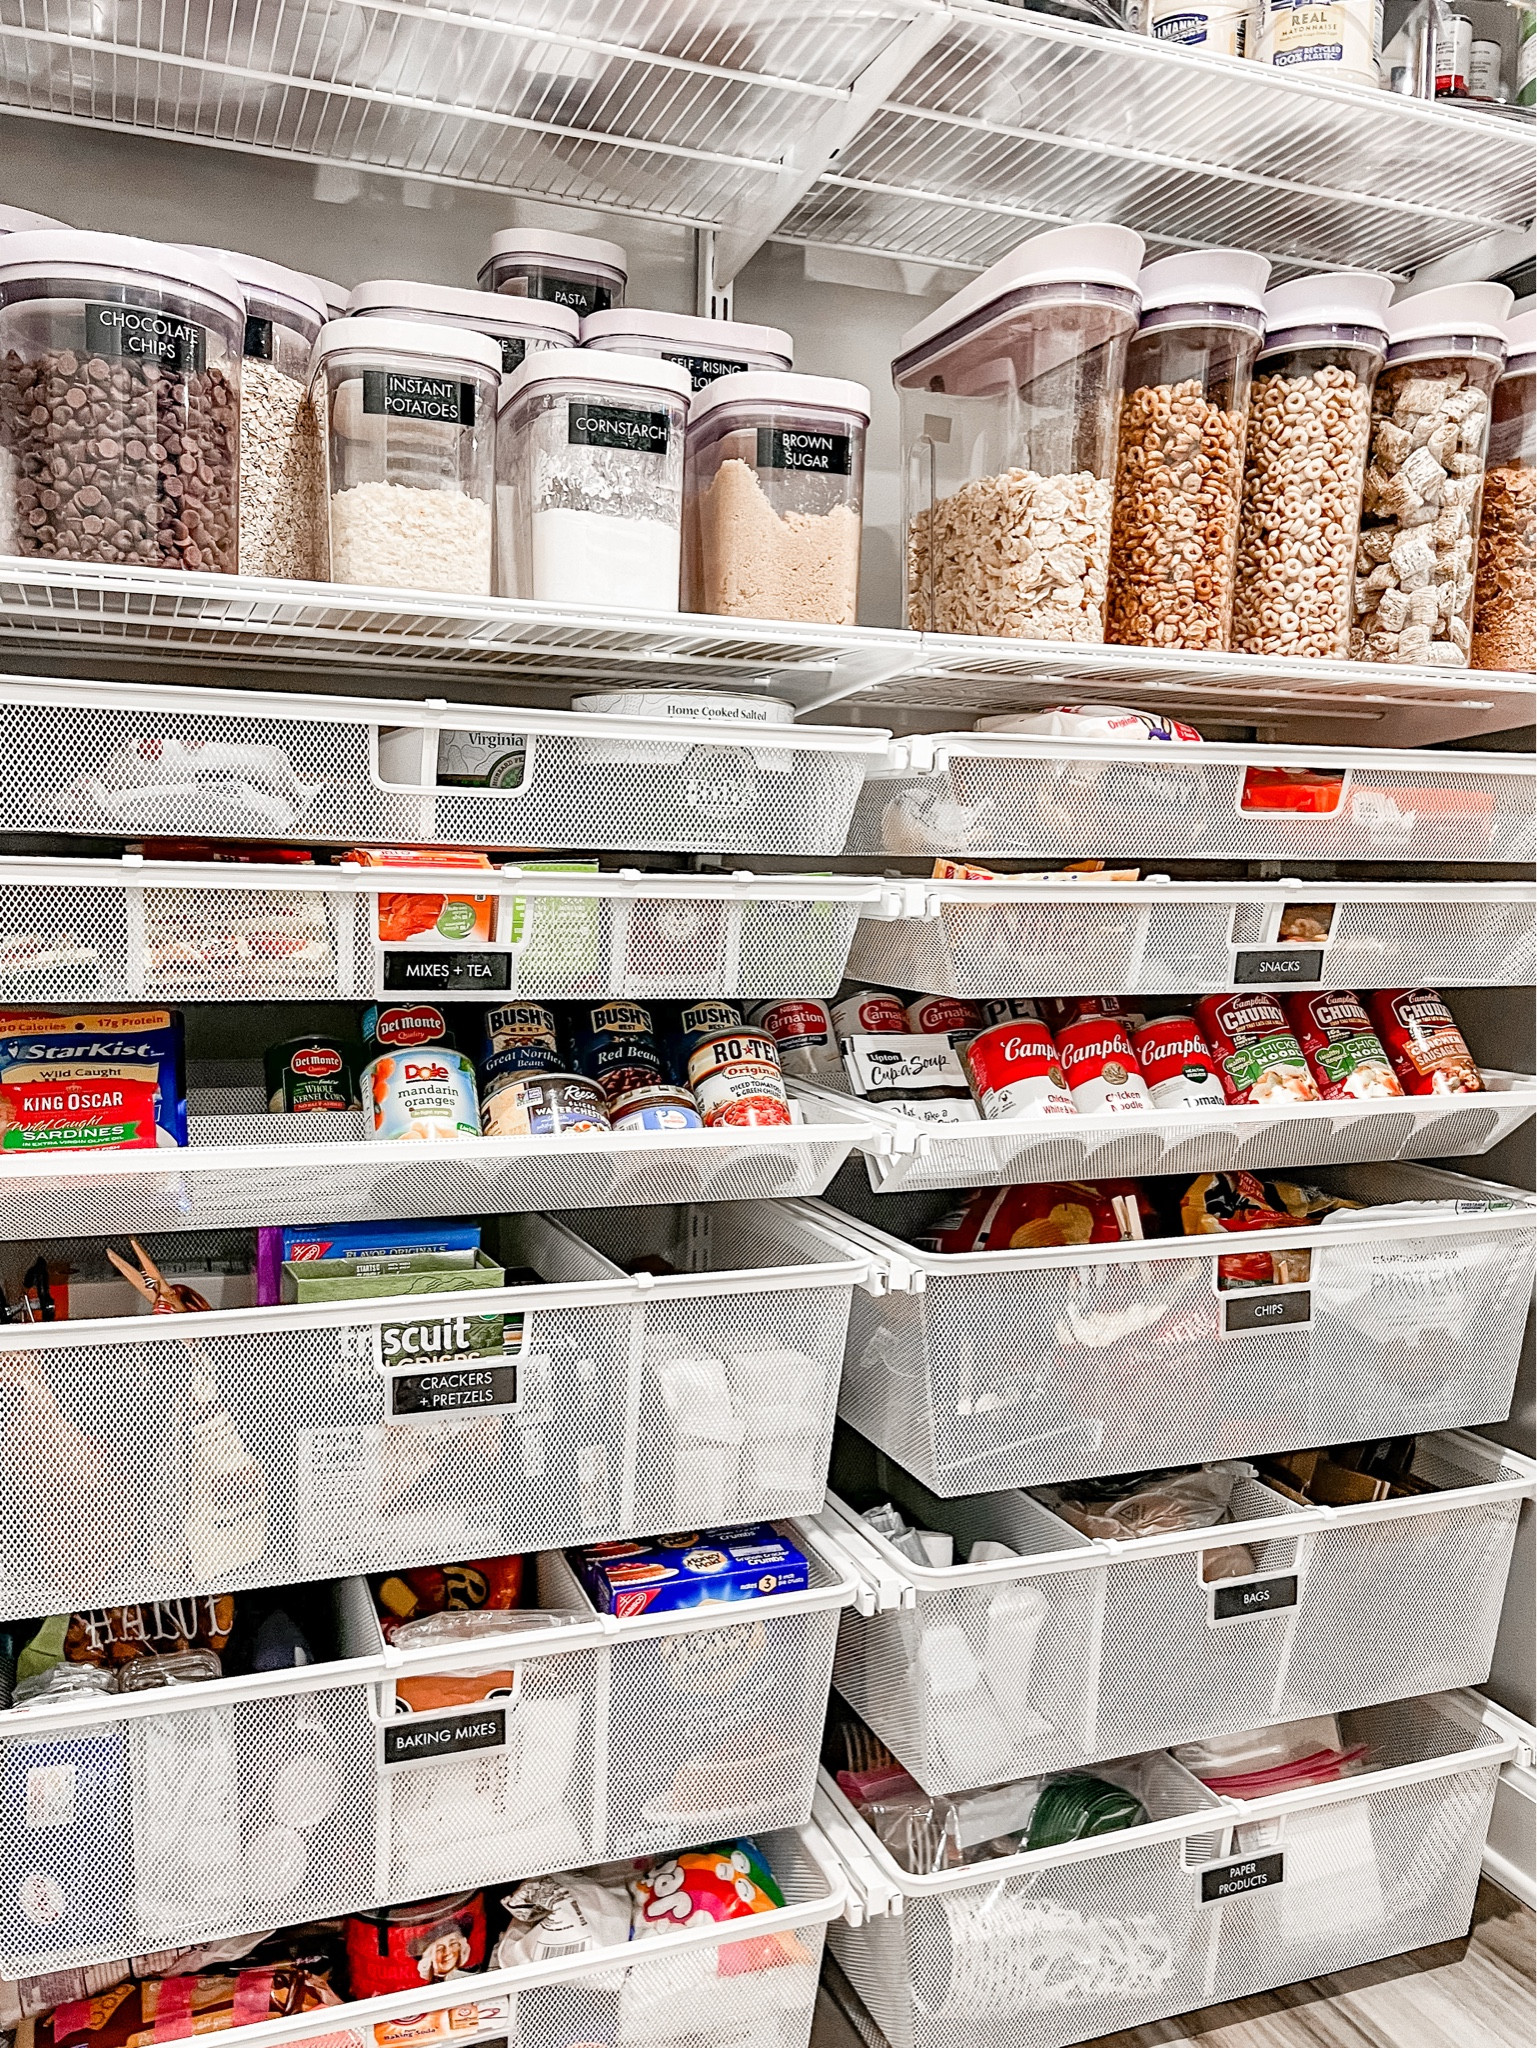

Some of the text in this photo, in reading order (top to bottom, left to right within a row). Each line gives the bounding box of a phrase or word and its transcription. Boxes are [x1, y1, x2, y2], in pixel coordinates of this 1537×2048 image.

[1292, 12, 1327, 26] REAL
[1282, 24, 1337, 36] MAYONNAISE
[1275, 53, 1303, 66] 100%
[555, 291, 588, 307] PASTA
[100, 310, 199, 344] CHOCOLATE
[128, 337, 176, 359] CHIPS
[389, 377, 453, 398] INSTANT
[385, 397, 458, 419] POTATOES
[576, 417, 668, 440] CORNSTARCH
[782, 433, 833, 450] BROWN
[785, 452, 829, 469] SUGAR
[667, 705, 767, 722] Home Cooked Salted
[1107, 716, 1139, 730] Original
[469, 733, 524, 748] Virginia
[406, 964, 449, 977] MIXES
[467, 965, 492, 977] TEA
[1259, 960, 1301, 973] SNACKS
[97, 1016, 164, 1029] 17g Protein
[491, 1008, 554, 1035] BUSH'S
[594, 1008, 653, 1031] BUSH'S
[684, 1008, 741, 1031] BUSH'S
[766, 1011, 825, 1034] Carnation
[1223, 1006, 1284, 1030] CHUNKY
[19, 1022, 66, 1031] Calories
[381, 1019, 400, 1035] Del
[401, 1017, 441, 1029] Monte
[25, 1041, 152, 1059] StarKist
[1411, 1036, 1461, 1056] CICKEN
[295, 1056, 339, 1067] Del Monte
[486, 1048, 565, 1071] Great Northern
[598, 1046, 660, 1065] Red Beans
[870, 1054, 899, 1063] Lipton
[1416, 1044, 1456, 1066] SAUSAGE
[518, 1059, 544, 1067] Beans
[40, 1068, 121, 1078] Wild Caught
[405, 1063, 449, 1080] Dole
[728, 1065, 779, 1078] Original
[305, 1085, 333, 1093] WHOLE
[398, 1084, 459, 1099] mandarin
[730, 1081, 750, 1092] DICED
[24, 1092, 123, 1111] KING OSCAR
[293, 1092, 345, 1104] KERNEL CORN
[404, 1096, 456, 1107] oranges
[1105, 1091, 1141, 1102] Cicken
[535, 1107, 571, 1115] WAER
[568, 1101, 597, 1110] SLICED
[7, 1115, 103, 1132] Wild Caught
[23, 1126, 125, 1141] SARDINES
[1254, 1303, 1284, 1317] CHIPS
[421, 1372, 493, 1390] CRACKERS
[433, 1389, 494, 1406] PRETZELS
[686, 1552, 720, 1567] Honey
[694, 1559, 721, 1569] Maid
[748, 1556, 785, 1565] Crumbs
[764, 1578, 771, 1589] 3
[1243, 1590, 1270, 1604] BAGS
[396, 1722, 497, 1749] BAKING MIXES
[1230, 1863, 1256, 1878] PAPER
[1219, 1874, 1268, 1894] PRODUCTS
[383, 2028, 436, 2042] Baking Soda
